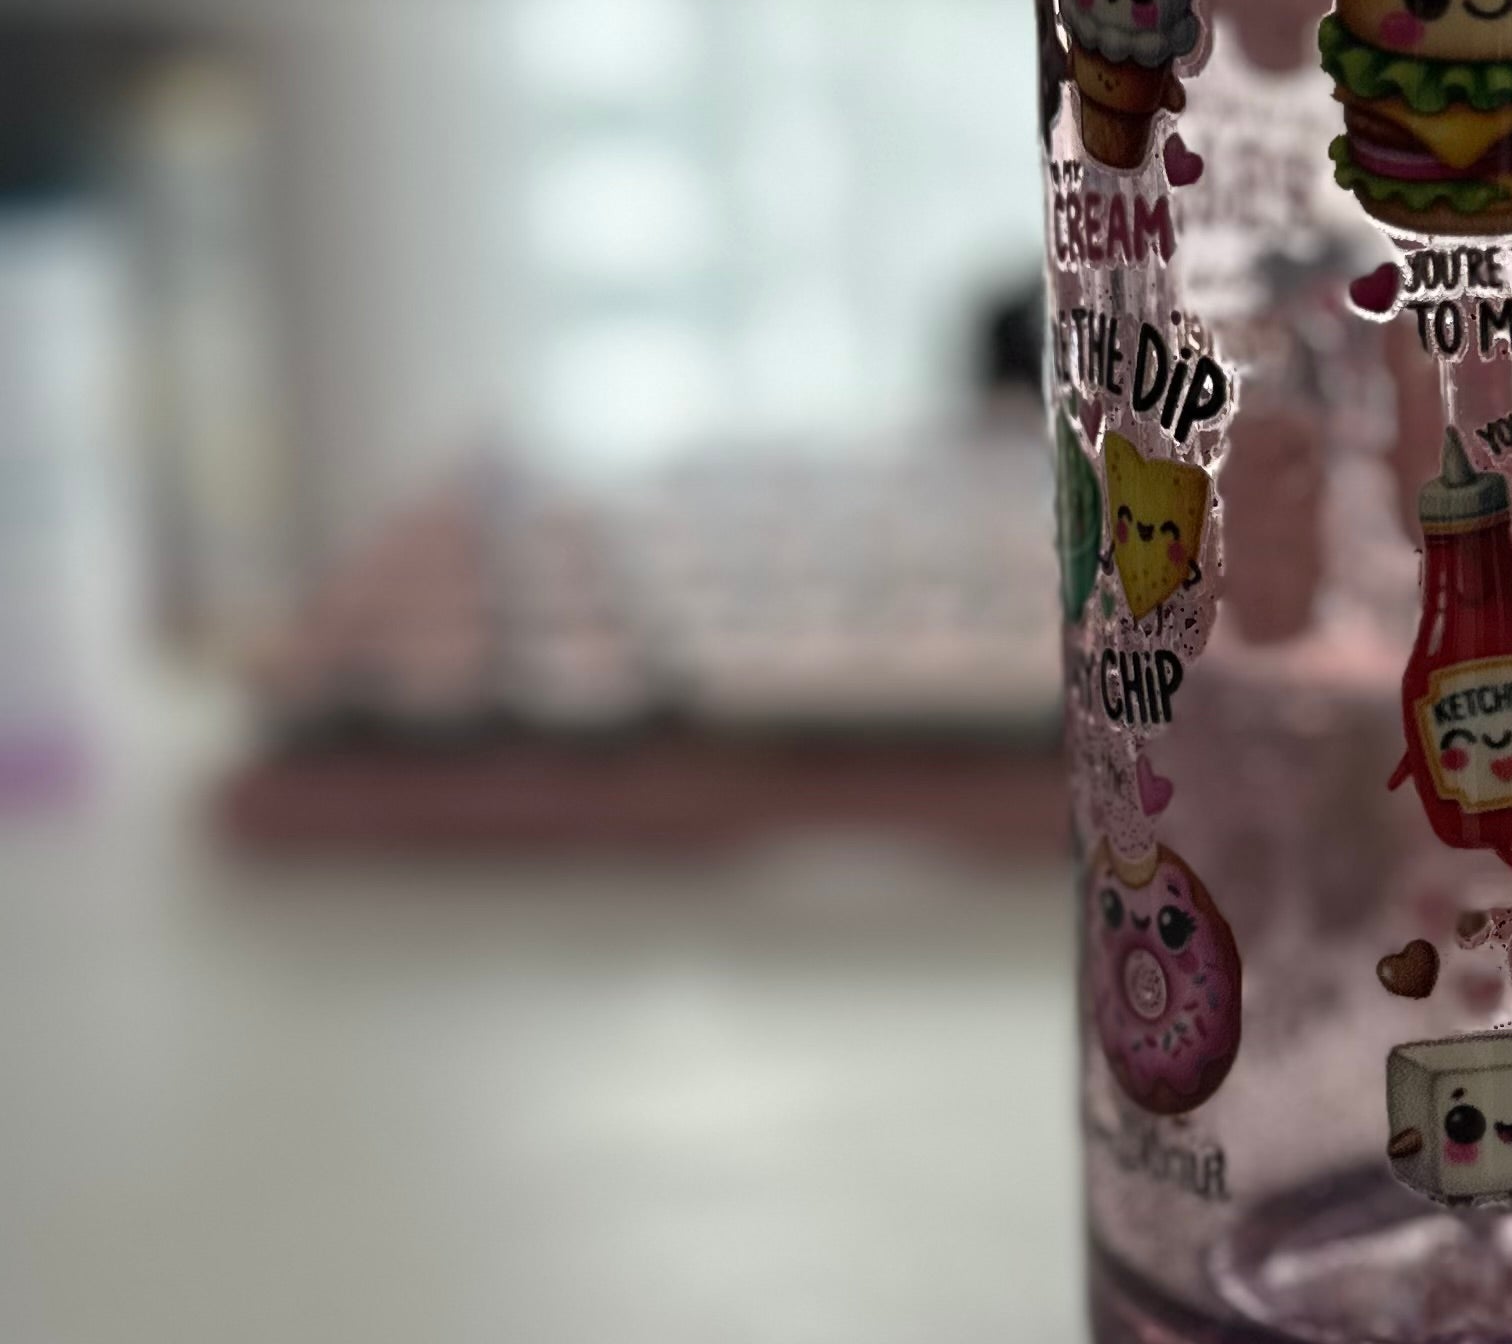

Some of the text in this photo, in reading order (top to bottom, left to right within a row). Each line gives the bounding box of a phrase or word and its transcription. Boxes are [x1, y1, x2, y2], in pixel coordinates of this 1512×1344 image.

[1054, 192, 1177, 262] CREAM
[1071, 308, 1123, 395] THE
[1404, 300, 1463, 354] TO
